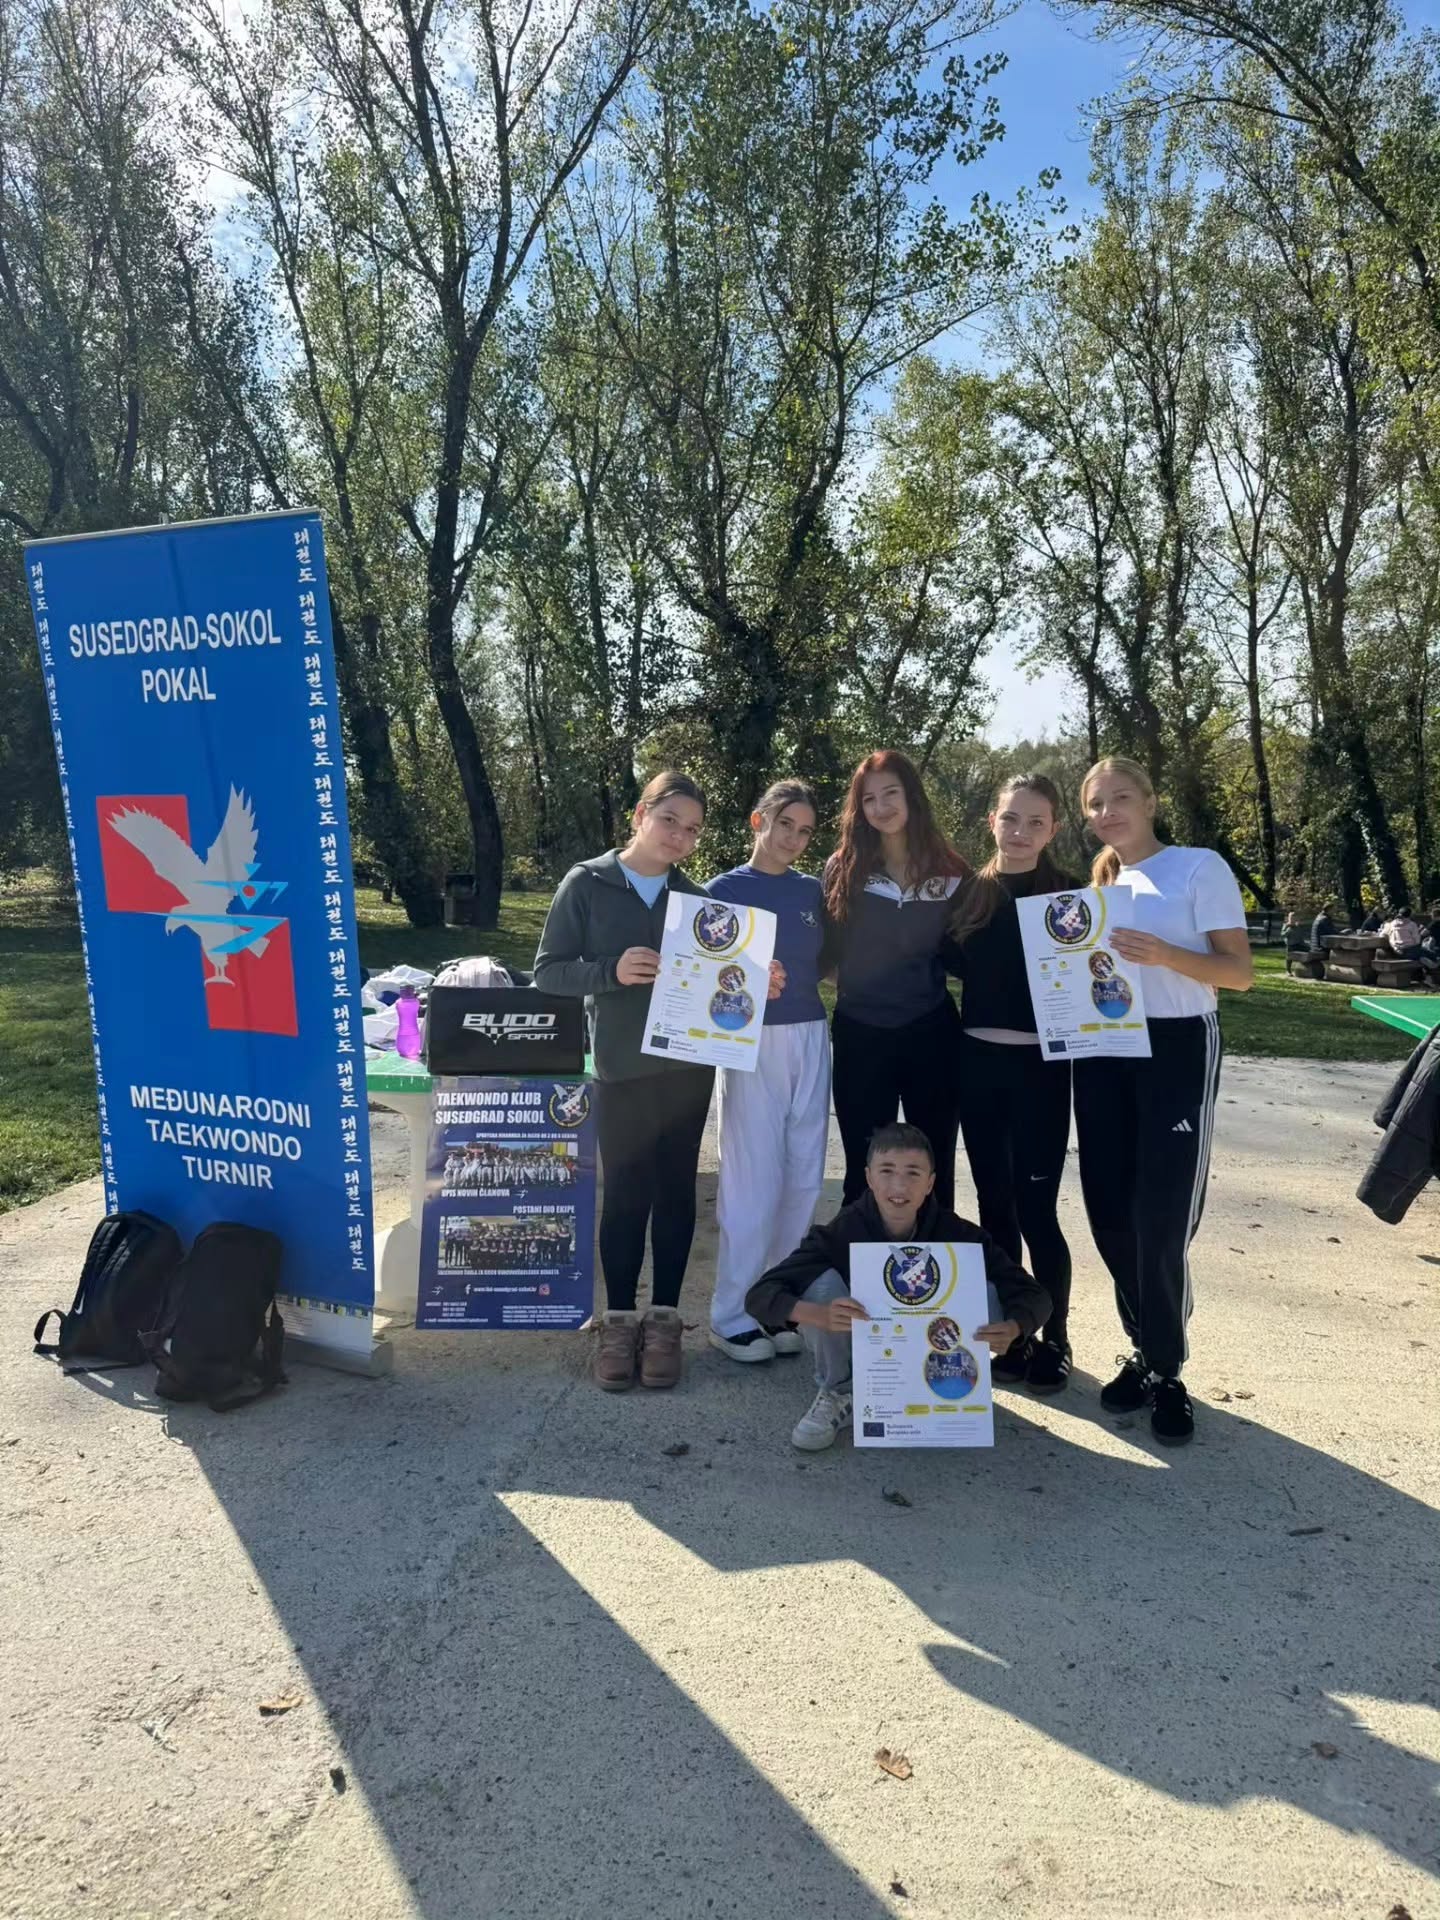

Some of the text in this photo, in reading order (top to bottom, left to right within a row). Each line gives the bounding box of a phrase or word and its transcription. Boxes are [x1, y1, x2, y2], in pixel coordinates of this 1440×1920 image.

[69, 608, 281, 658] SUSEDGRAD-SOKOL
[141, 666, 217, 703] POKAL
[462, 1013, 556, 1027] BUDO
[507, 1033, 559, 1041] SPORT
[130, 1085, 311, 1128] MEĐUNARODNI
[437, 1091, 542, 1106] TAEKWONDO KLUB
[435, 1110, 545, 1125] SUSEDGRAD SOKOL
[146, 1119, 302, 1161] TAEKWONDO
[182, 1155, 274, 1189] TURNIR
[513, 1205, 541, 1214] POSTANI
[556, 1205, 575, 1214] EKIPE
